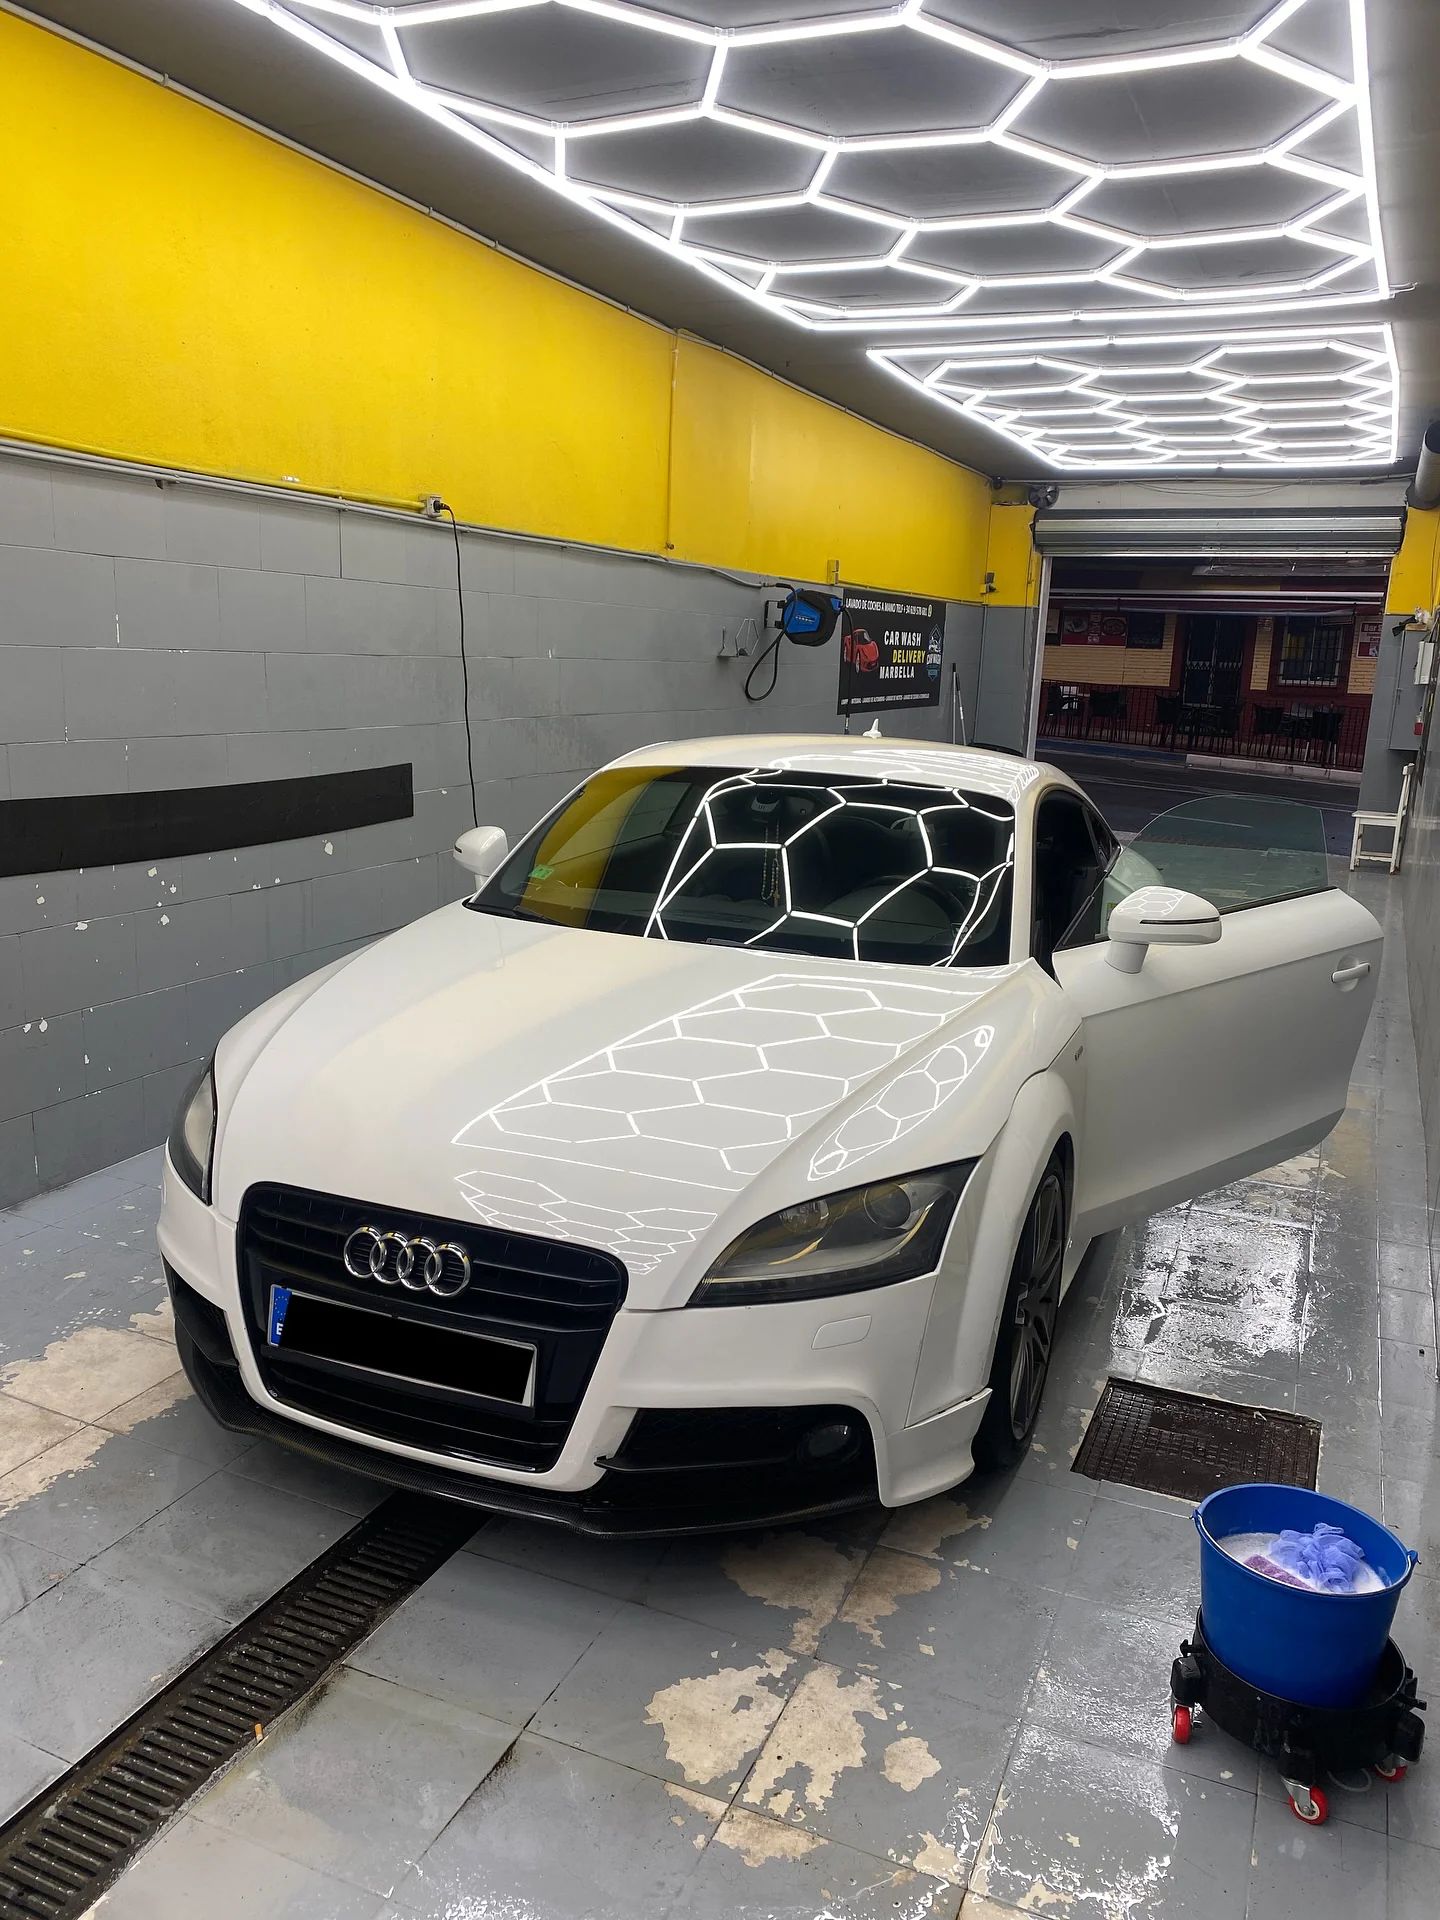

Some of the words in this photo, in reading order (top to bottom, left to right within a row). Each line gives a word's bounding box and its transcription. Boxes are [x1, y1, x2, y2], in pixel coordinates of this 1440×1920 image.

[845, 598, 861, 609] LAVADO
[862, 599, 867, 610] DE
[867, 600, 881, 611] COCHES
[884, 602, 896, 613] MANO
[884, 630, 899, 646] CAR
[901, 631, 921, 647] WASH
[892, 649, 926, 664] DELIVERY
[880, 666, 915, 679] MARBELLA
[276, 1322, 284, 1335] E
